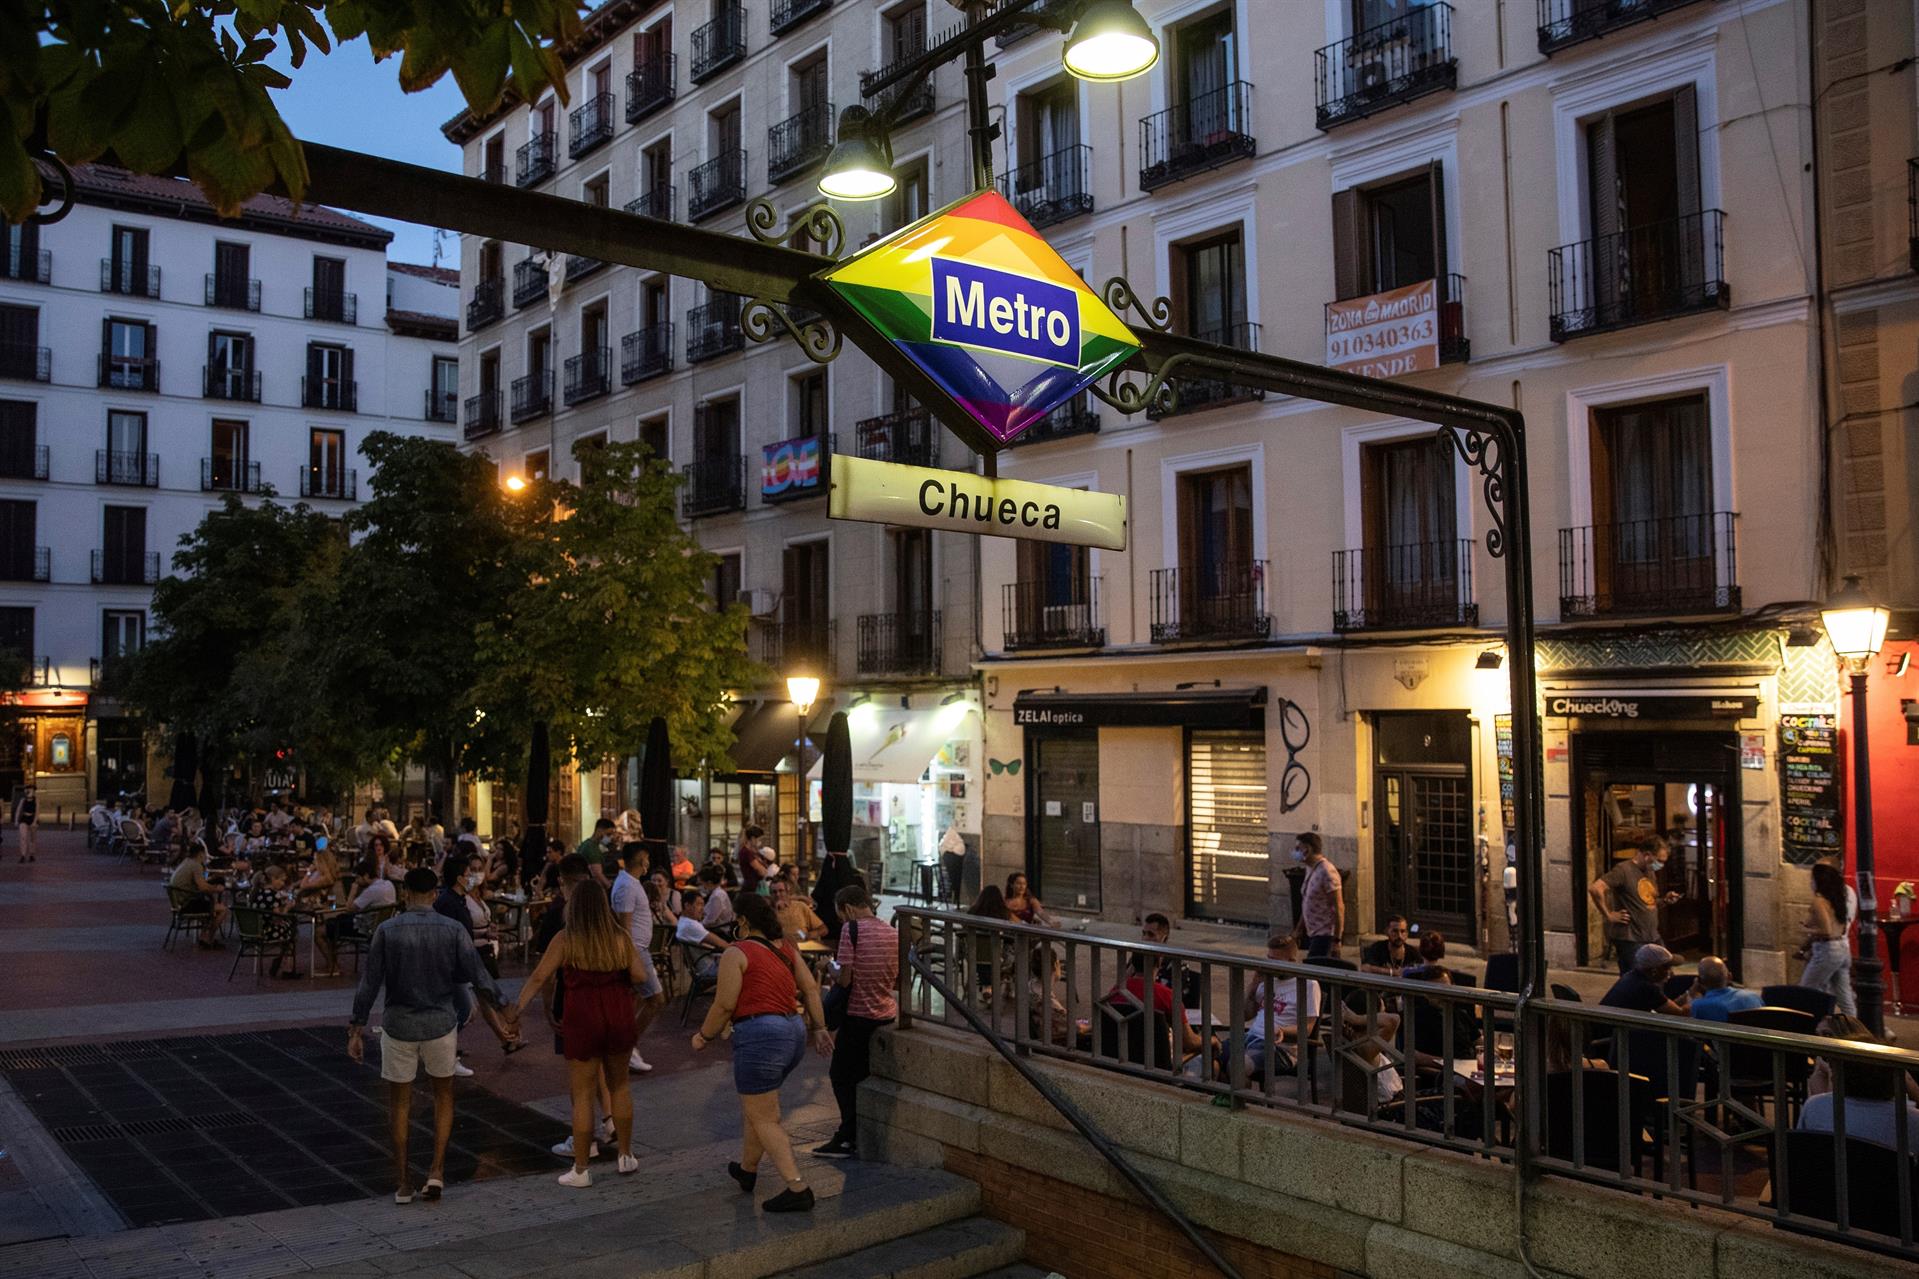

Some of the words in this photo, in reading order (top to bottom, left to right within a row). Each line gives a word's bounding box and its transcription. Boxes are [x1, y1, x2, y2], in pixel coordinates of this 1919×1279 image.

[945, 275, 1071, 347] Metro
[1331, 310, 1363, 331] ZONA
[1380, 293, 1432, 319] MADRID
[1331, 319, 1434, 359] 910340363
[919, 479, 1061, 530] Chueca
[1018, 710, 1052, 723] ZELAI
